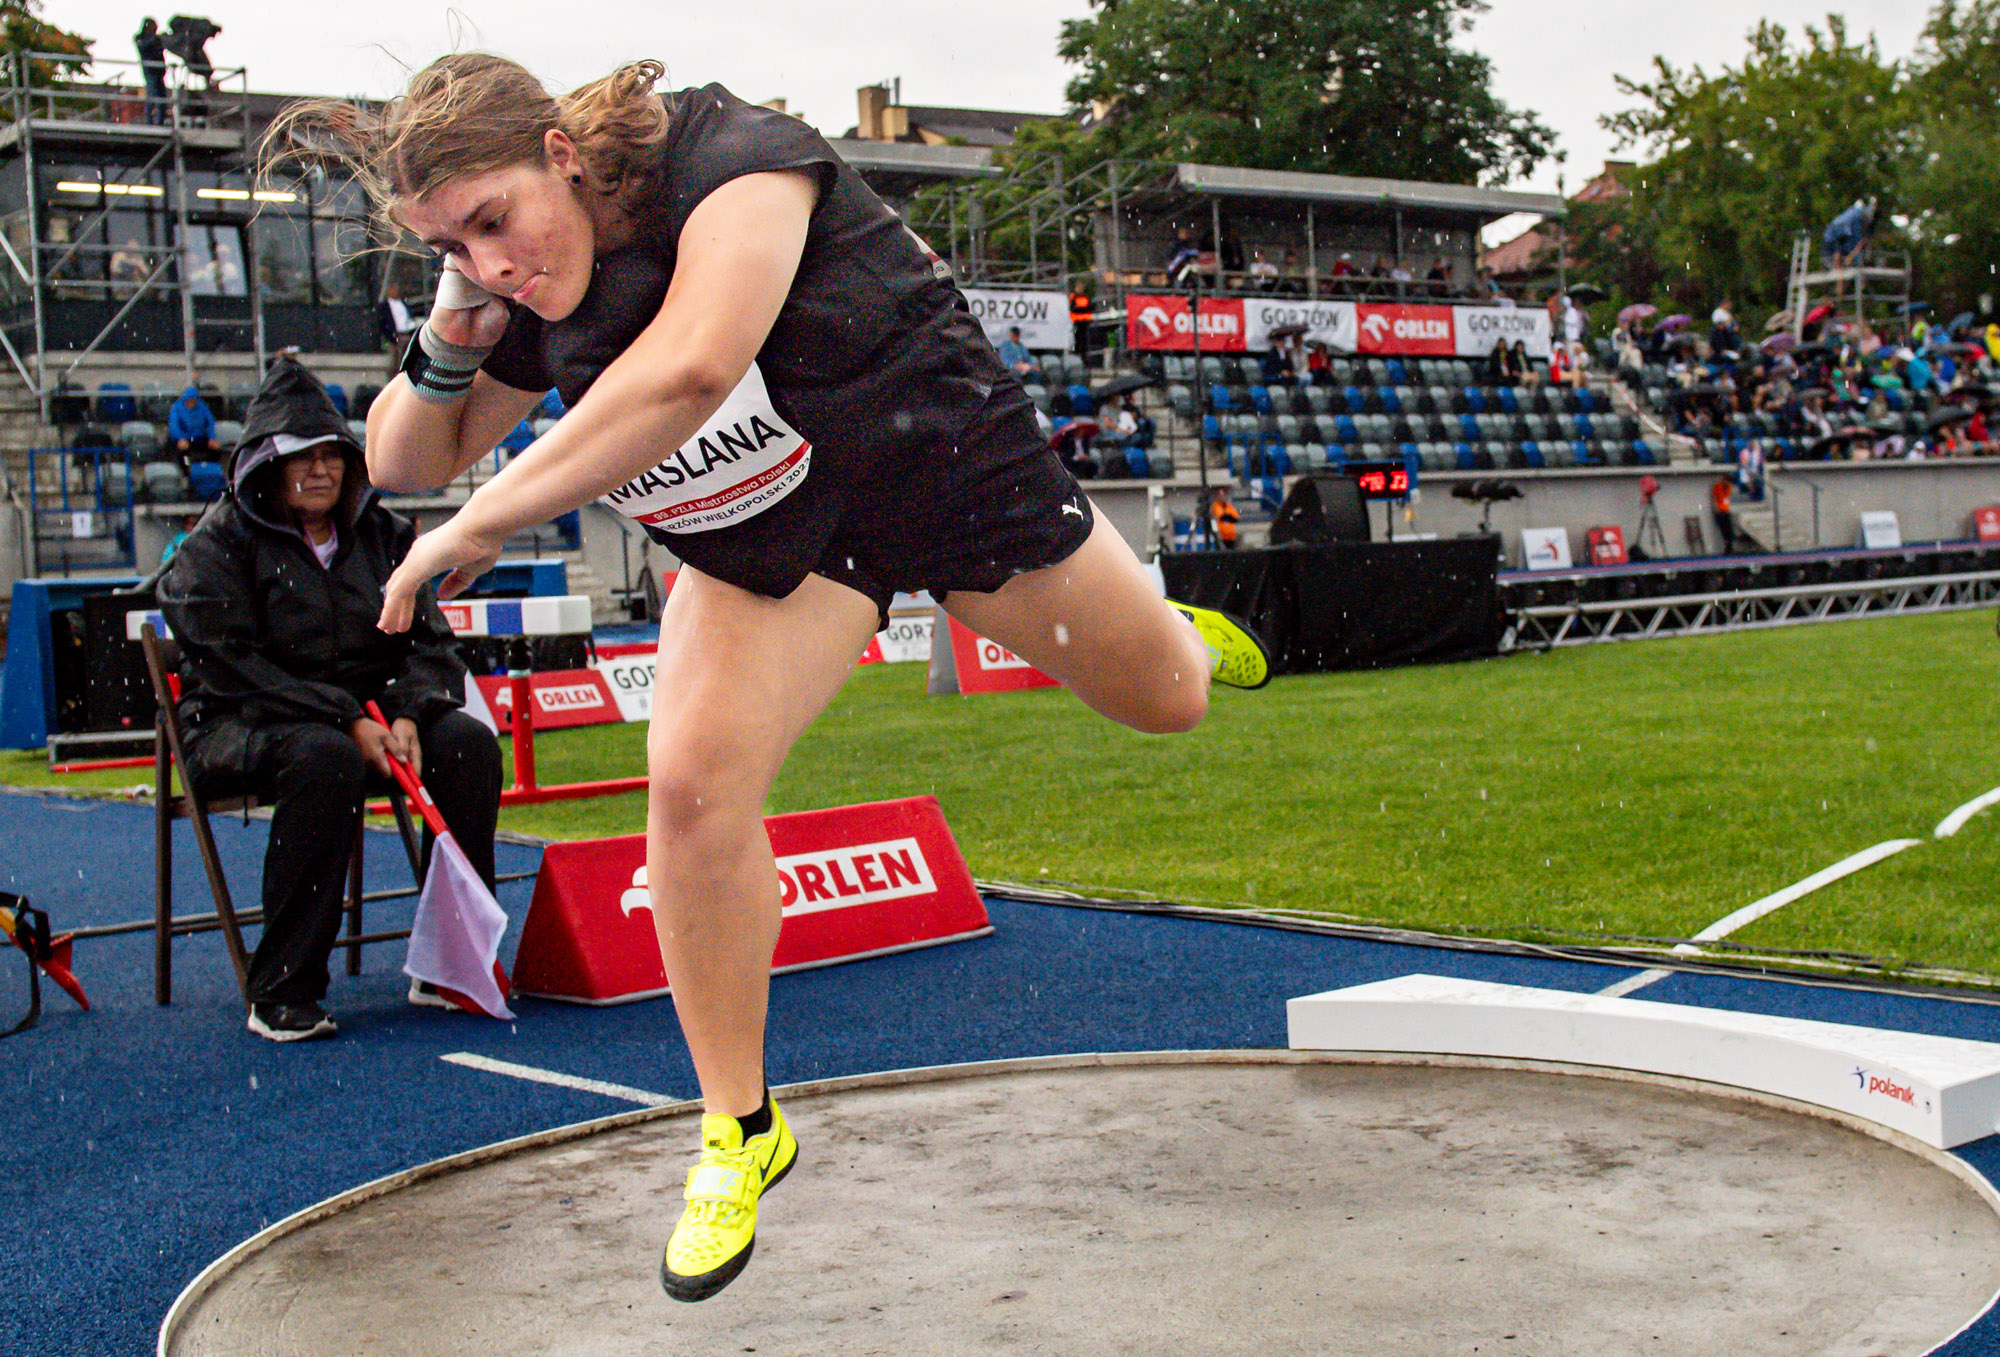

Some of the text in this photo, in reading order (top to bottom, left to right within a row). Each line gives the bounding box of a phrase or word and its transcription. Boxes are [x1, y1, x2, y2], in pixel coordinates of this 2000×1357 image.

[971, 295, 1048, 319] ORZÓW
[1174, 312, 1238, 334] ORLEN
[1393, 319, 1449, 339] ORLEN
[671, 503, 697, 515] PZLA
[695, 481, 759, 510] Mistrzostwa
[758, 461, 791, 484] Polski
[702, 481, 787, 522] WIELKOPOLSKI
[542, 688, 598, 706] ORLEN
[1869, 1076, 1915, 1107] polanik
